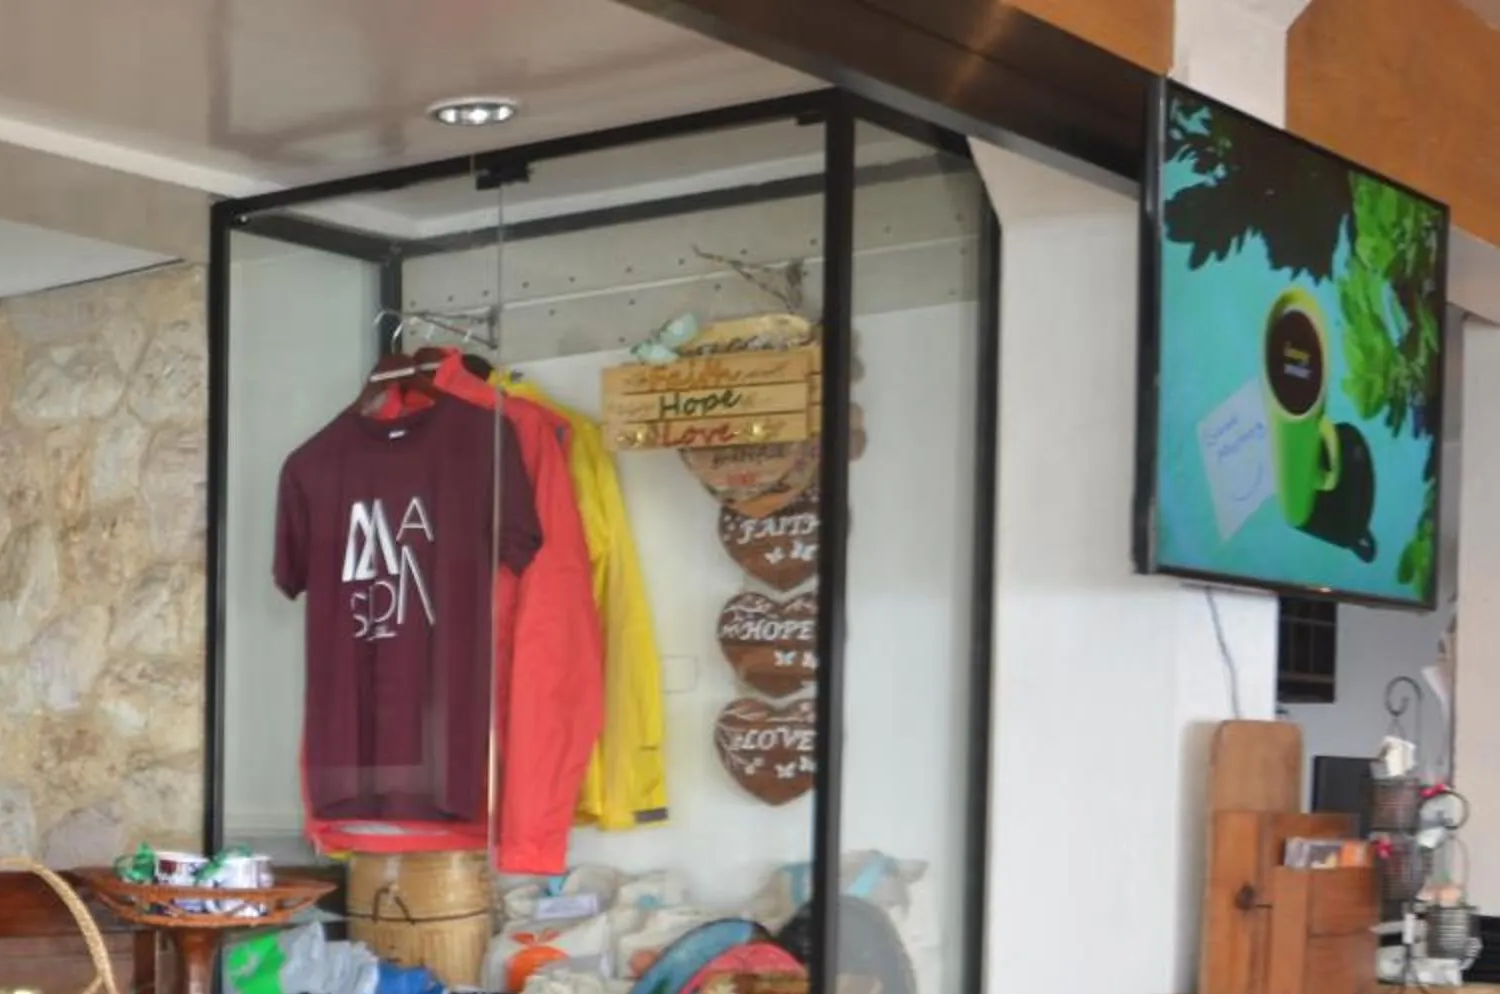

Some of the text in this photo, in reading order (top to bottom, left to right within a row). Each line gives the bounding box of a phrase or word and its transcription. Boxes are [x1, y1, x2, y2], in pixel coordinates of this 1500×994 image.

[659, 390, 741, 418] Hope
[661, 422, 738, 447] Love
[739, 619, 816, 641] HOPE
[741, 727, 817, 751] LOVE
